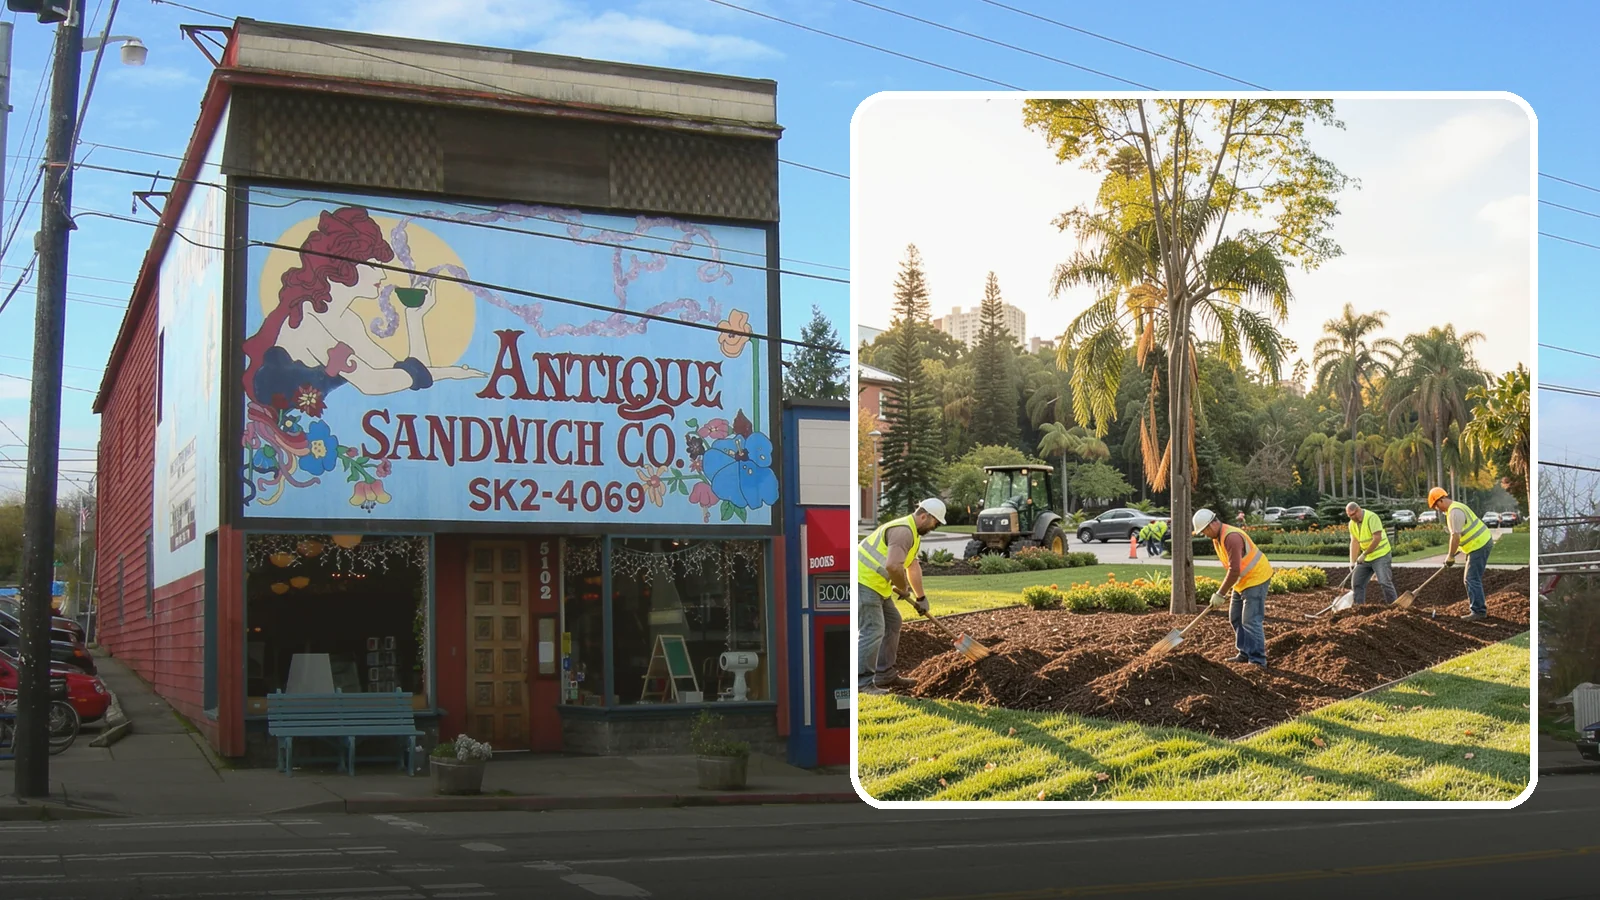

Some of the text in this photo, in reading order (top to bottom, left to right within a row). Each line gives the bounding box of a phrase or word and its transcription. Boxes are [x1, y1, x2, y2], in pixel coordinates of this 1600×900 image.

[475, 329, 724, 421] ANTIQUE
[361, 408, 684, 469] SANDWICH CO.
[468, 477, 645, 513] SK2-4069
[540, 541, 551, 600] 5102
[809, 555, 835, 569] BOOKS
